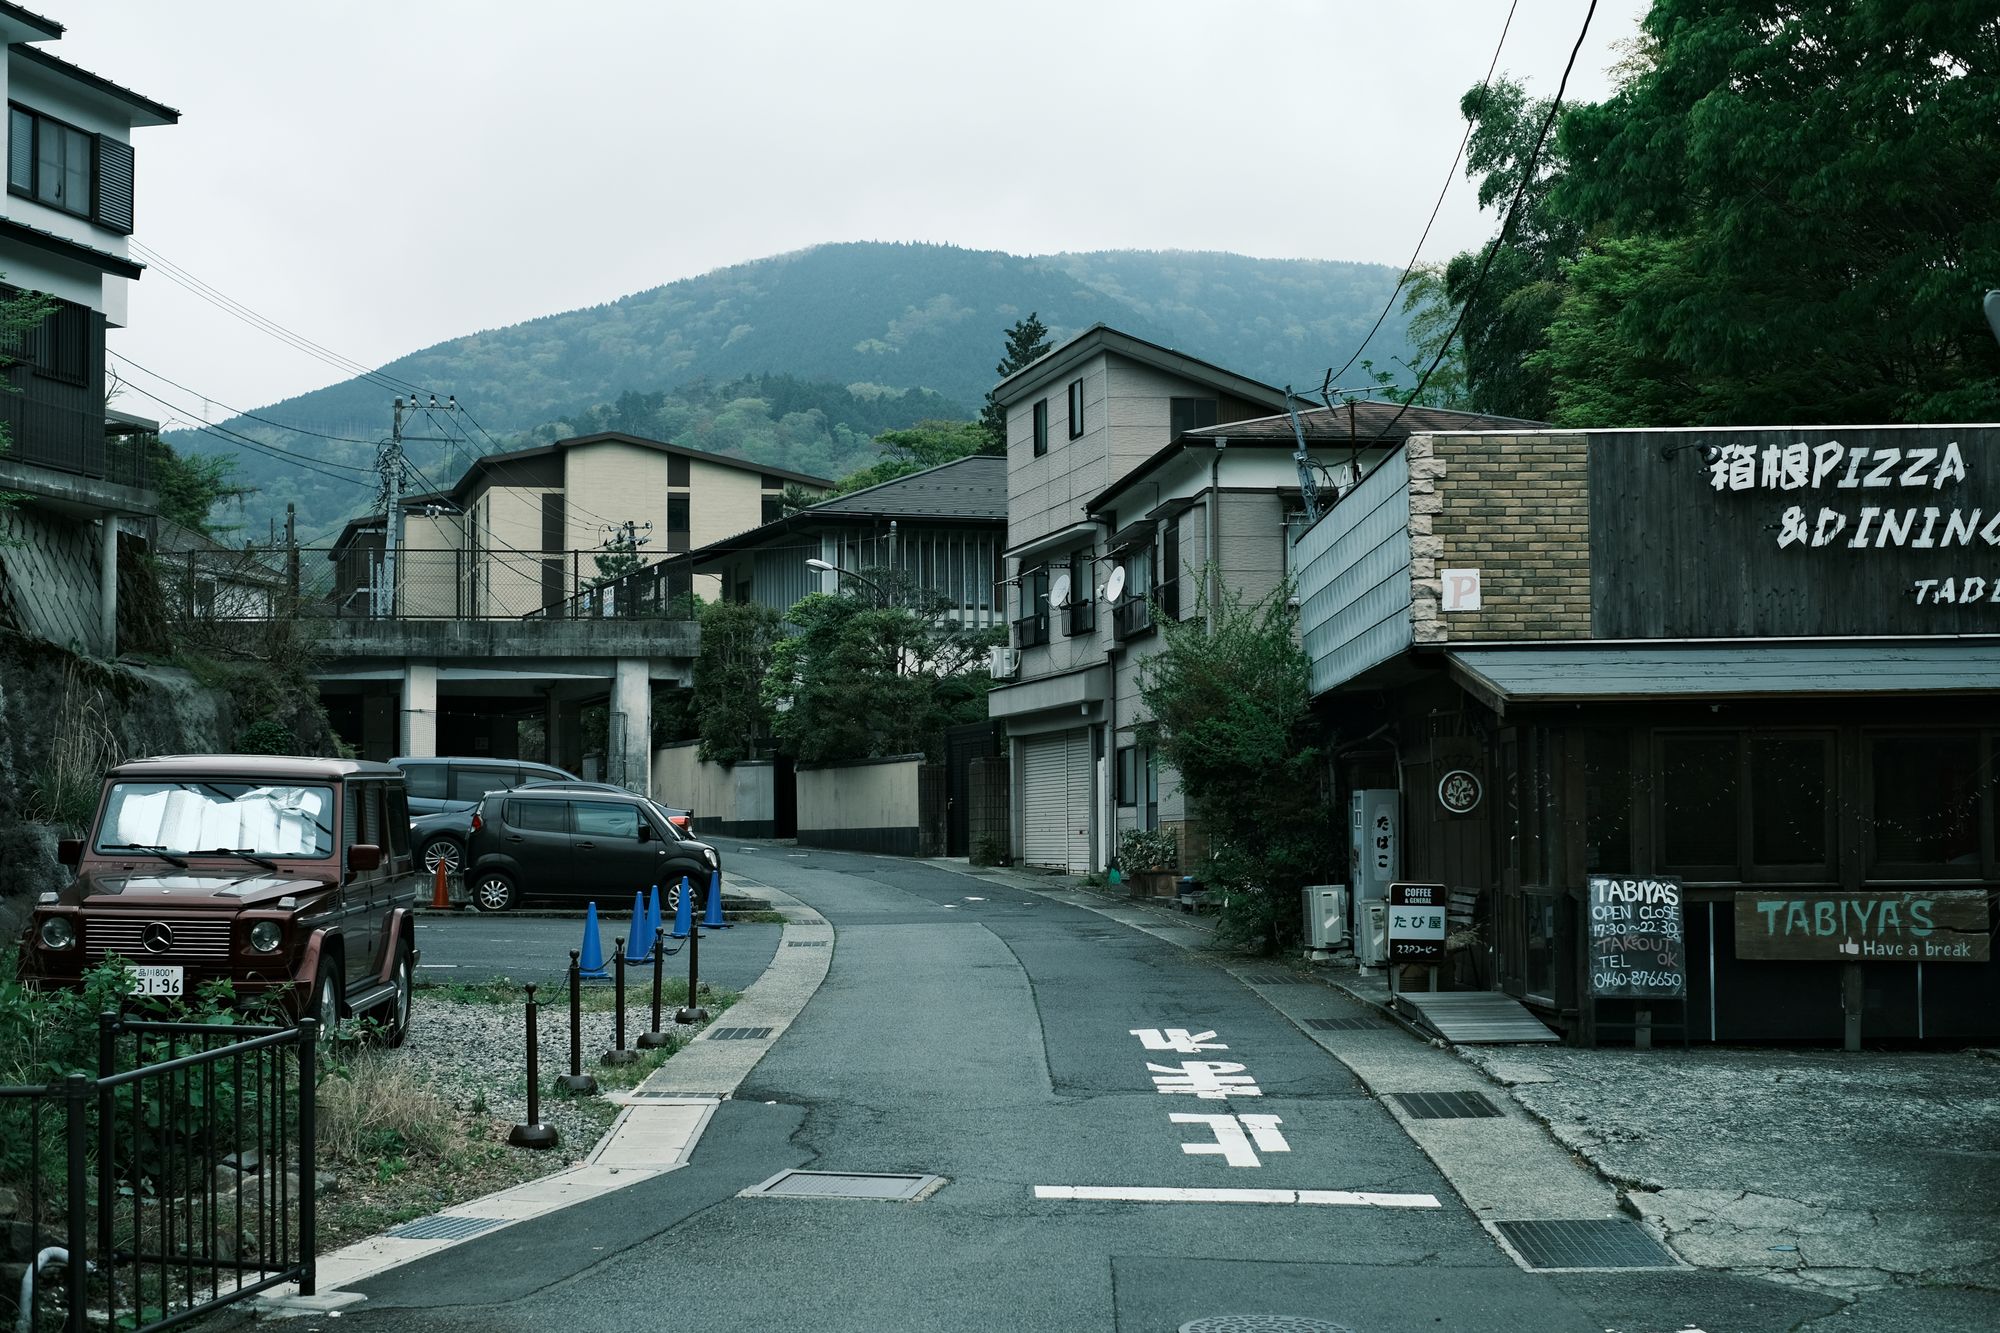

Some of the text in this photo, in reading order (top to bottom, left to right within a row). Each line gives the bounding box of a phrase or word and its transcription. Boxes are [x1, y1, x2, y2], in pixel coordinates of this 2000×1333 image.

[1449, 576, 1476, 608] P
[1376, 816, 1392, 868] たばこ
[1405, 888, 1432, 897] COFFEE
[1593, 880, 1679, 905] TABIYA'S
[1592, 905, 1631, 921] OPEN
[1757, 893, 1935, 936] TABIYA'S
[1394, 916, 1441, 928] たび屋
[1864, 940, 1971, 956] Have a break
[1599, 954, 1631, 968] TEL
[1657, 952, 1678, 967] OK
[137, 979, 180, 993] 51-96
[1129, 1028, 1291, 1167] 止まれ
